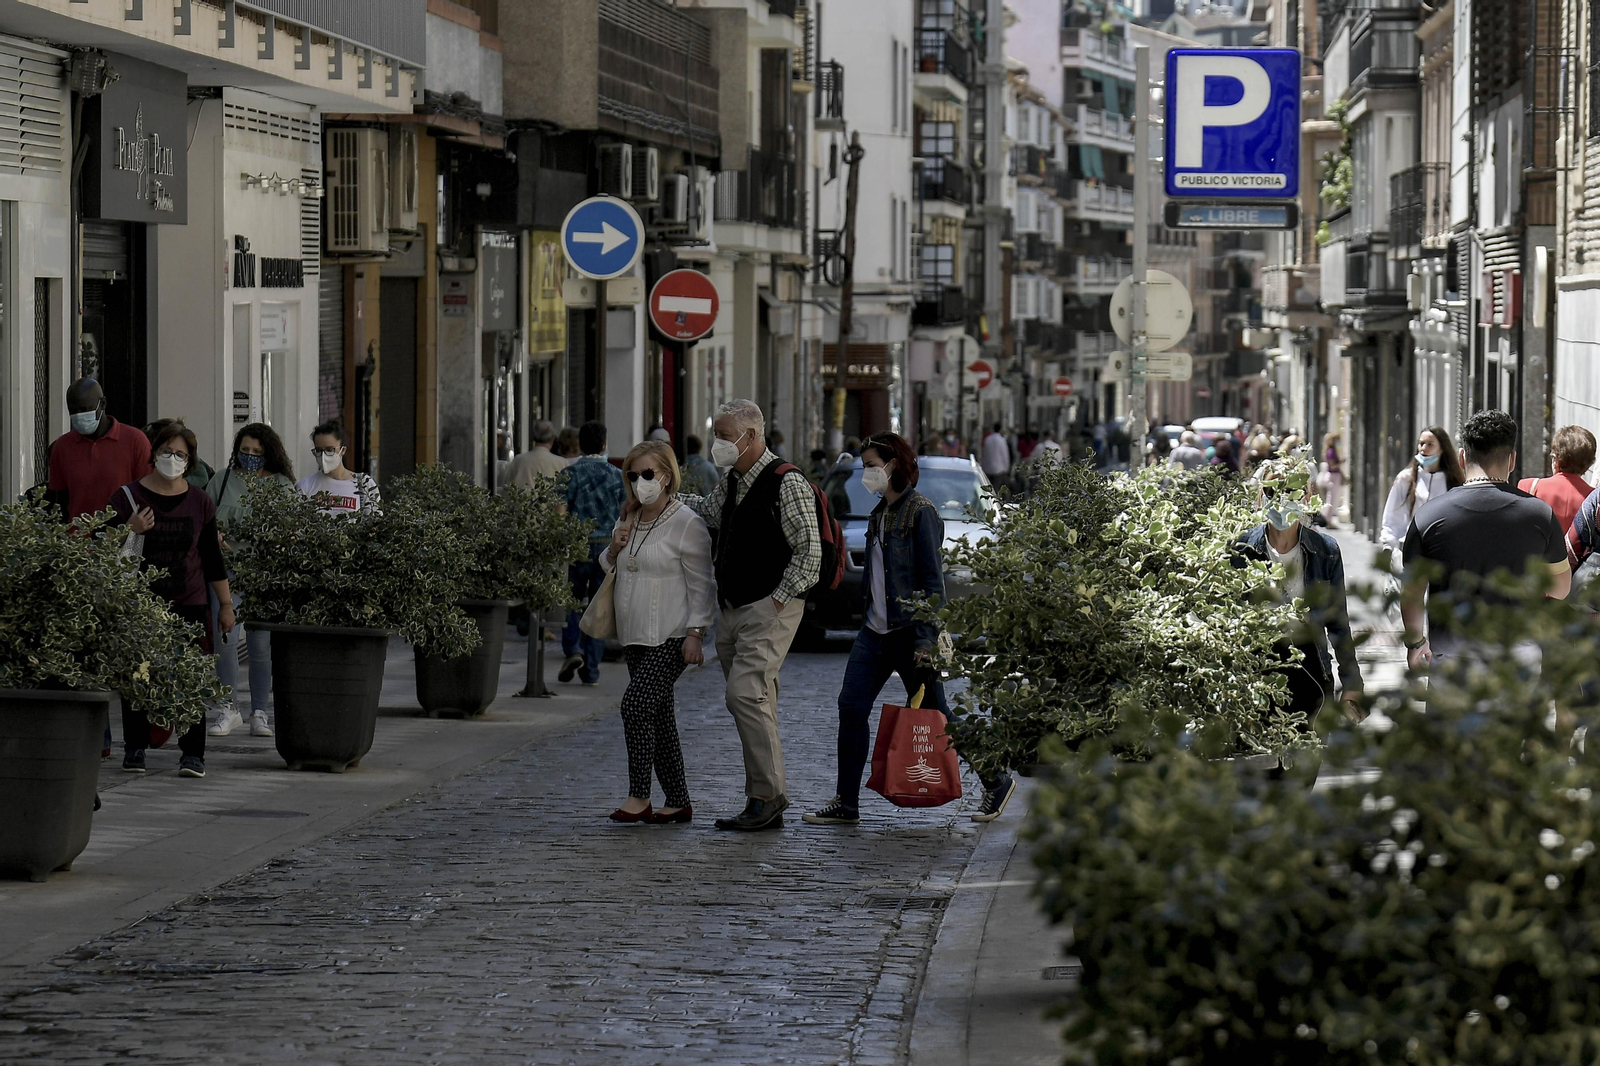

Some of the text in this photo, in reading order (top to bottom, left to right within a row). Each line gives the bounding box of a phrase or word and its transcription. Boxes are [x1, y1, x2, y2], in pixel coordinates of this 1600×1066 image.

[1175, 55, 1271, 168] P
[1181, 176, 1281, 185] PUBLICO VICTORIA
[1208, 210, 1259, 222] LIBRE
[913, 725, 931, 734] RUMBO
[918, 735, 929, 743] UNA
